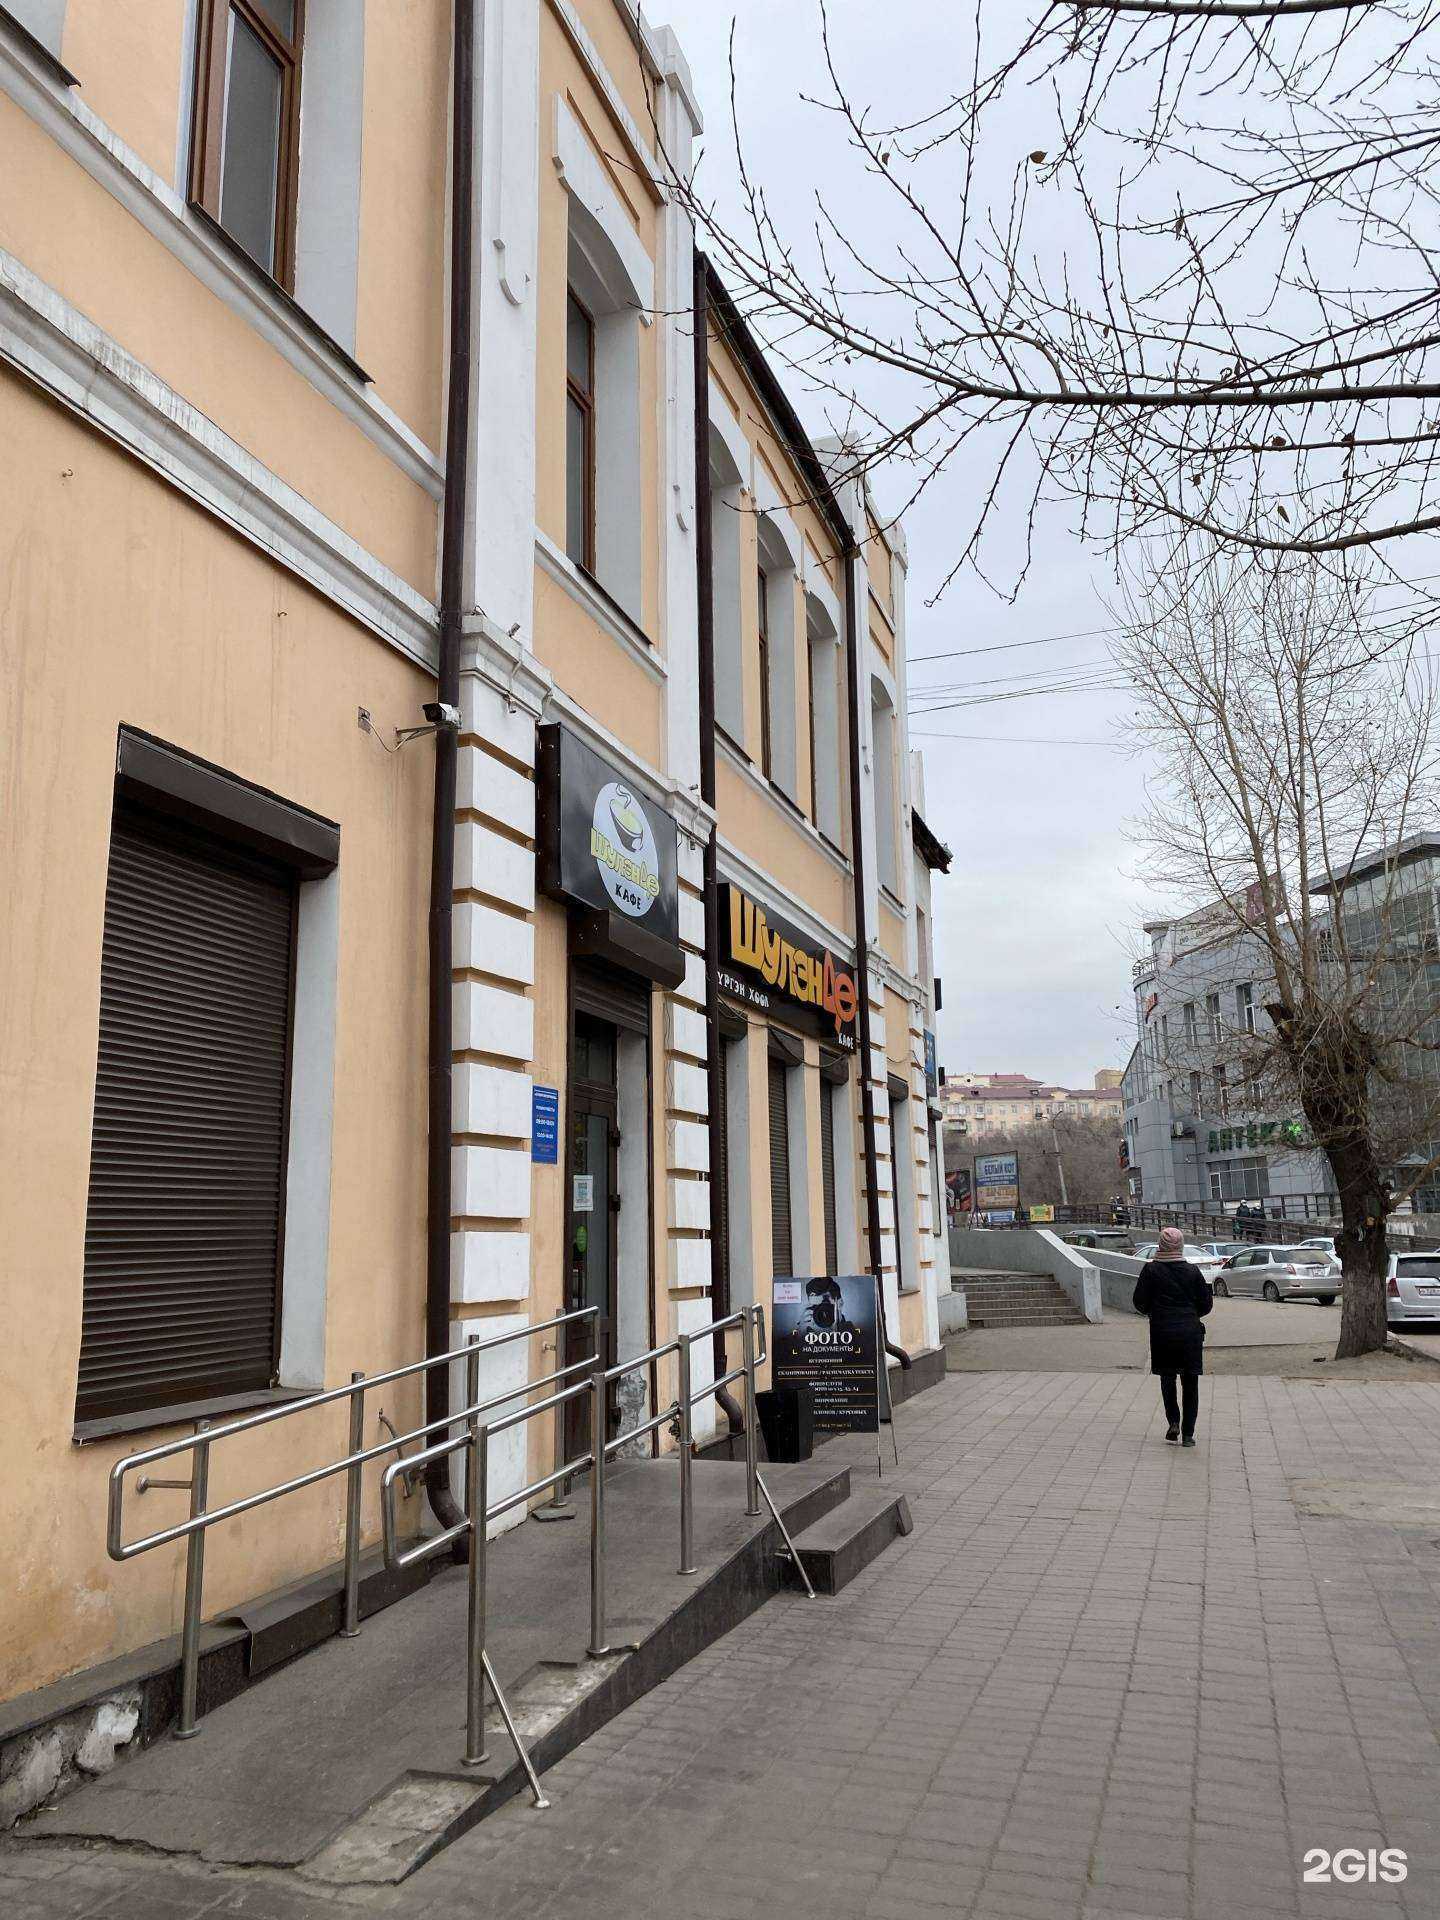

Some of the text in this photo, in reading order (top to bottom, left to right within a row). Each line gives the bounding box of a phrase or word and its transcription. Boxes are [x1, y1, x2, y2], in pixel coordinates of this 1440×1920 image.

[615, 883, 642, 910] КАФЕ
[804, 1331, 853, 1345] ФОТО
[813, 1345, 854, 1354] ДОКУМЕНТЫ
